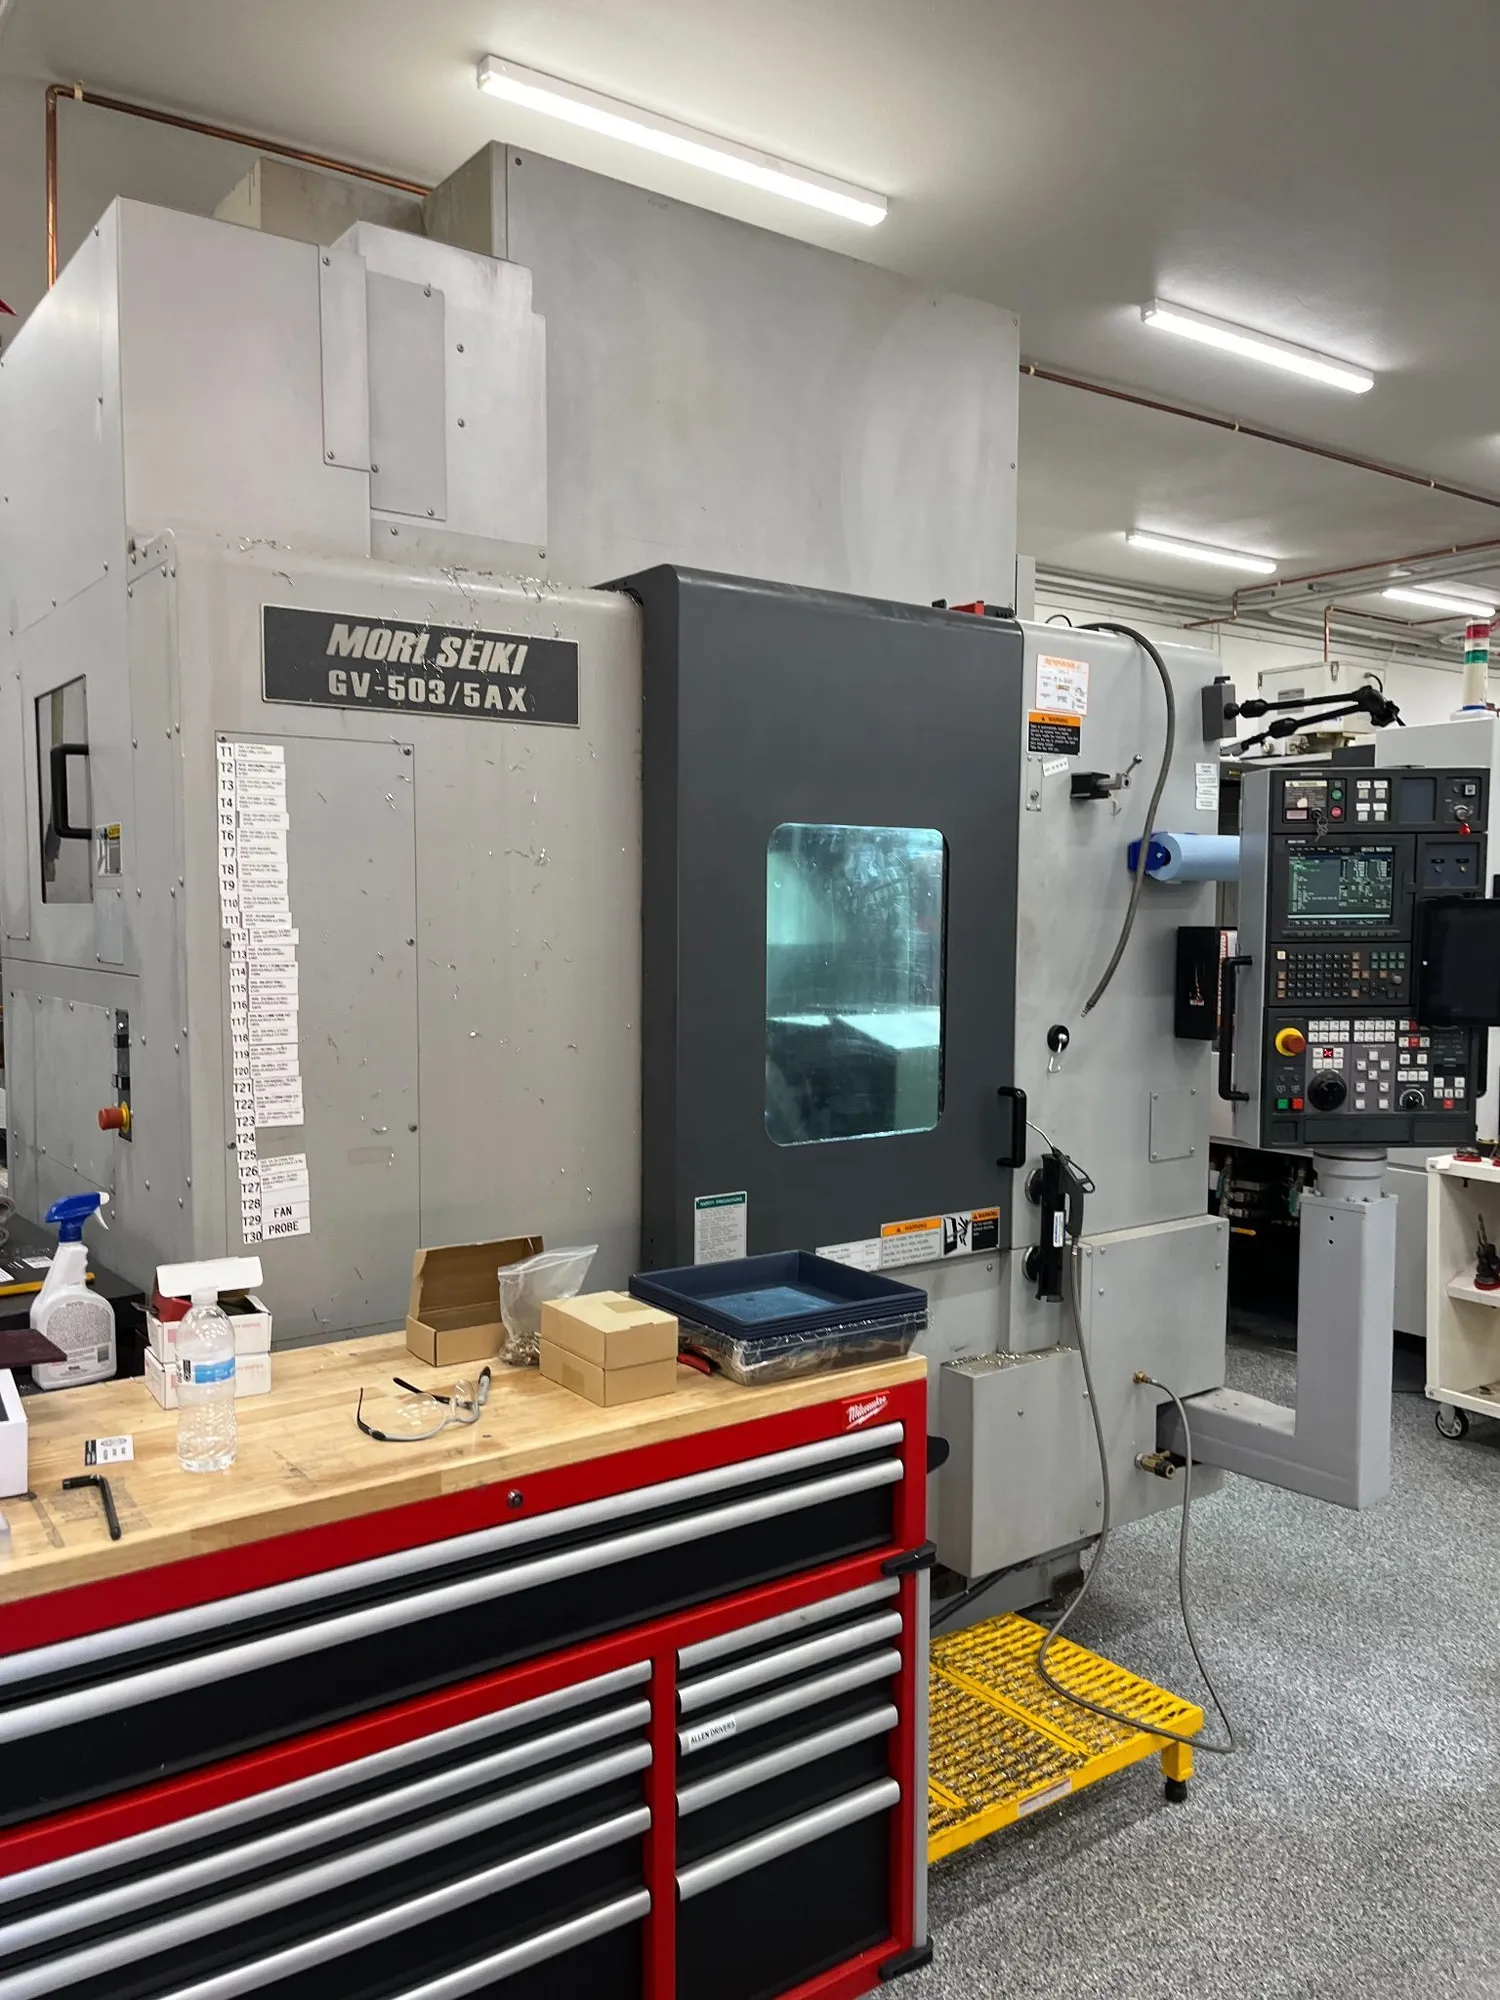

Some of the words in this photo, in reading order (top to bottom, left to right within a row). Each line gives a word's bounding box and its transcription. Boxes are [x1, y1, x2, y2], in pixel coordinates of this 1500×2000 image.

[326, 623, 430, 665] MORI
[436, 636, 528, 675] SEIKI
[328, 669, 527, 712] GV-503/5AX
[220, 746, 232, 757] T1
[220, 762, 233, 773] T2
[221, 780, 234, 791] T3
[220, 798, 233, 808] T4
[220, 814, 233, 825] T5
[221, 830, 234, 841] T6
[223, 847, 235, 858] T7
[221, 864, 234, 875] T8
[222, 880, 235, 891] T9
[223, 899, 238, 908] T10
[224, 916, 238, 924] T11
[231, 932, 246, 941] T12
[231, 950, 246, 959] T13
[231, 968, 246, 977] T14
[231, 984, 246, 993] T15
[232, 1001, 248, 1010] T16
[232, 1017, 246, 1026] T17
[233, 1034, 248, 1042] T18
[234, 1050, 249, 1059] T19
[234, 1067, 249, 1076] T20
[233, 1082, 251, 1093] T21
[235, 1099, 254, 1110] T22
[235, 1116, 255, 1127] T23
[236, 1132, 255, 1143] T24
[238, 1149, 256, 1160] T25
[239, 1166, 258, 1177] T26
[241, 1182, 260, 1193] T27
[242, 1199, 261, 1210] T28
[273, 1205, 292, 1218] FAN
[243, 1215, 261, 1226] T29
[268, 1221, 299, 1235] PROBE
[243, 1231, 262, 1243] T30
[691, 1732, 710, 1743] ALLEN
[710, 1720, 736, 1737] DRIVERS
